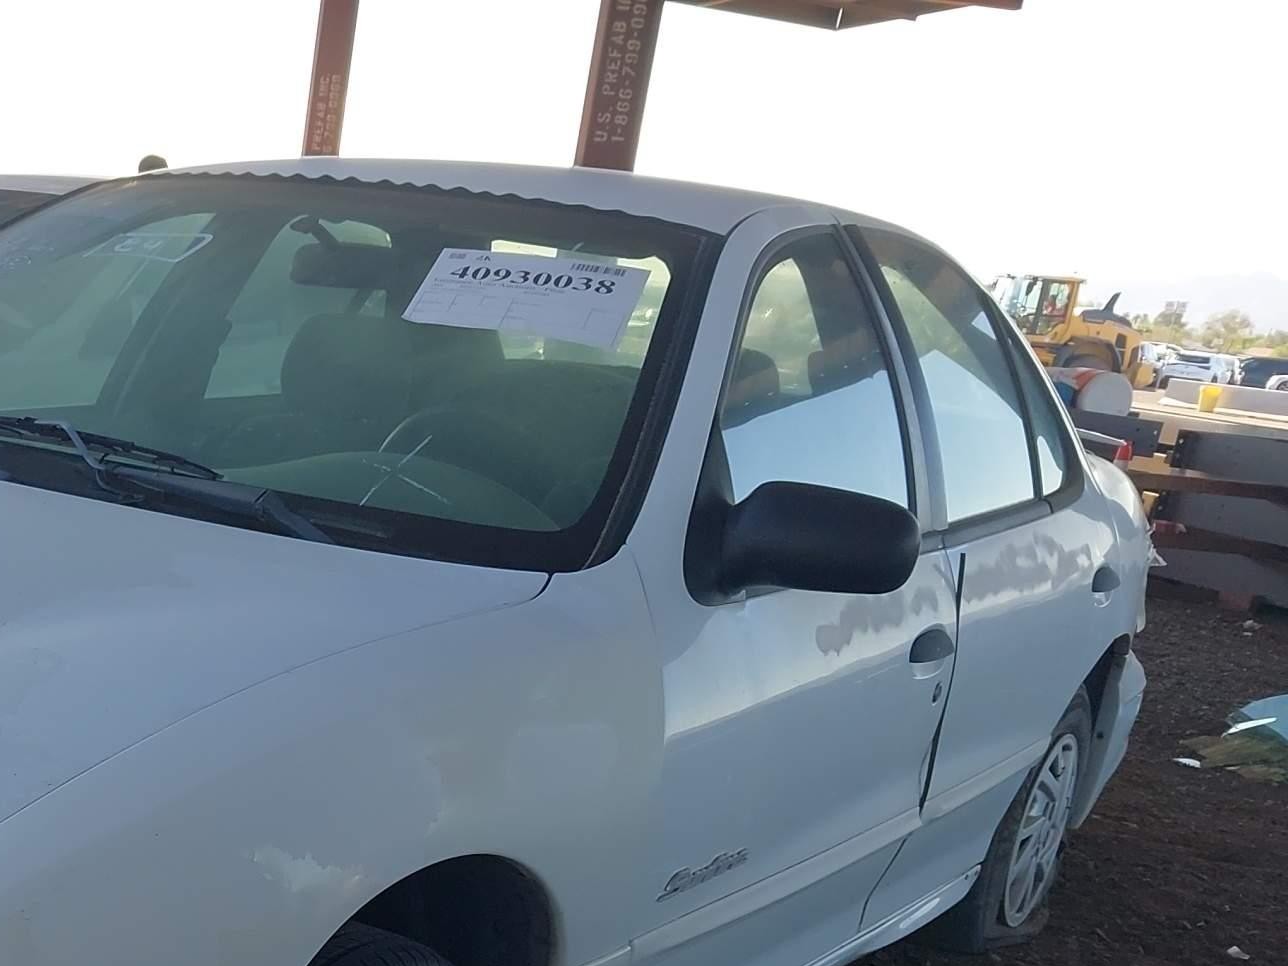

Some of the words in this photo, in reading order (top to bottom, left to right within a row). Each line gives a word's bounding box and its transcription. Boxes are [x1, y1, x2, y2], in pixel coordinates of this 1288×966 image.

[602, 21, 627, 95] PREFAB
[611, 0, 649, 141] 1-866-799-09
[450, 265, 616, 295] 40930038
